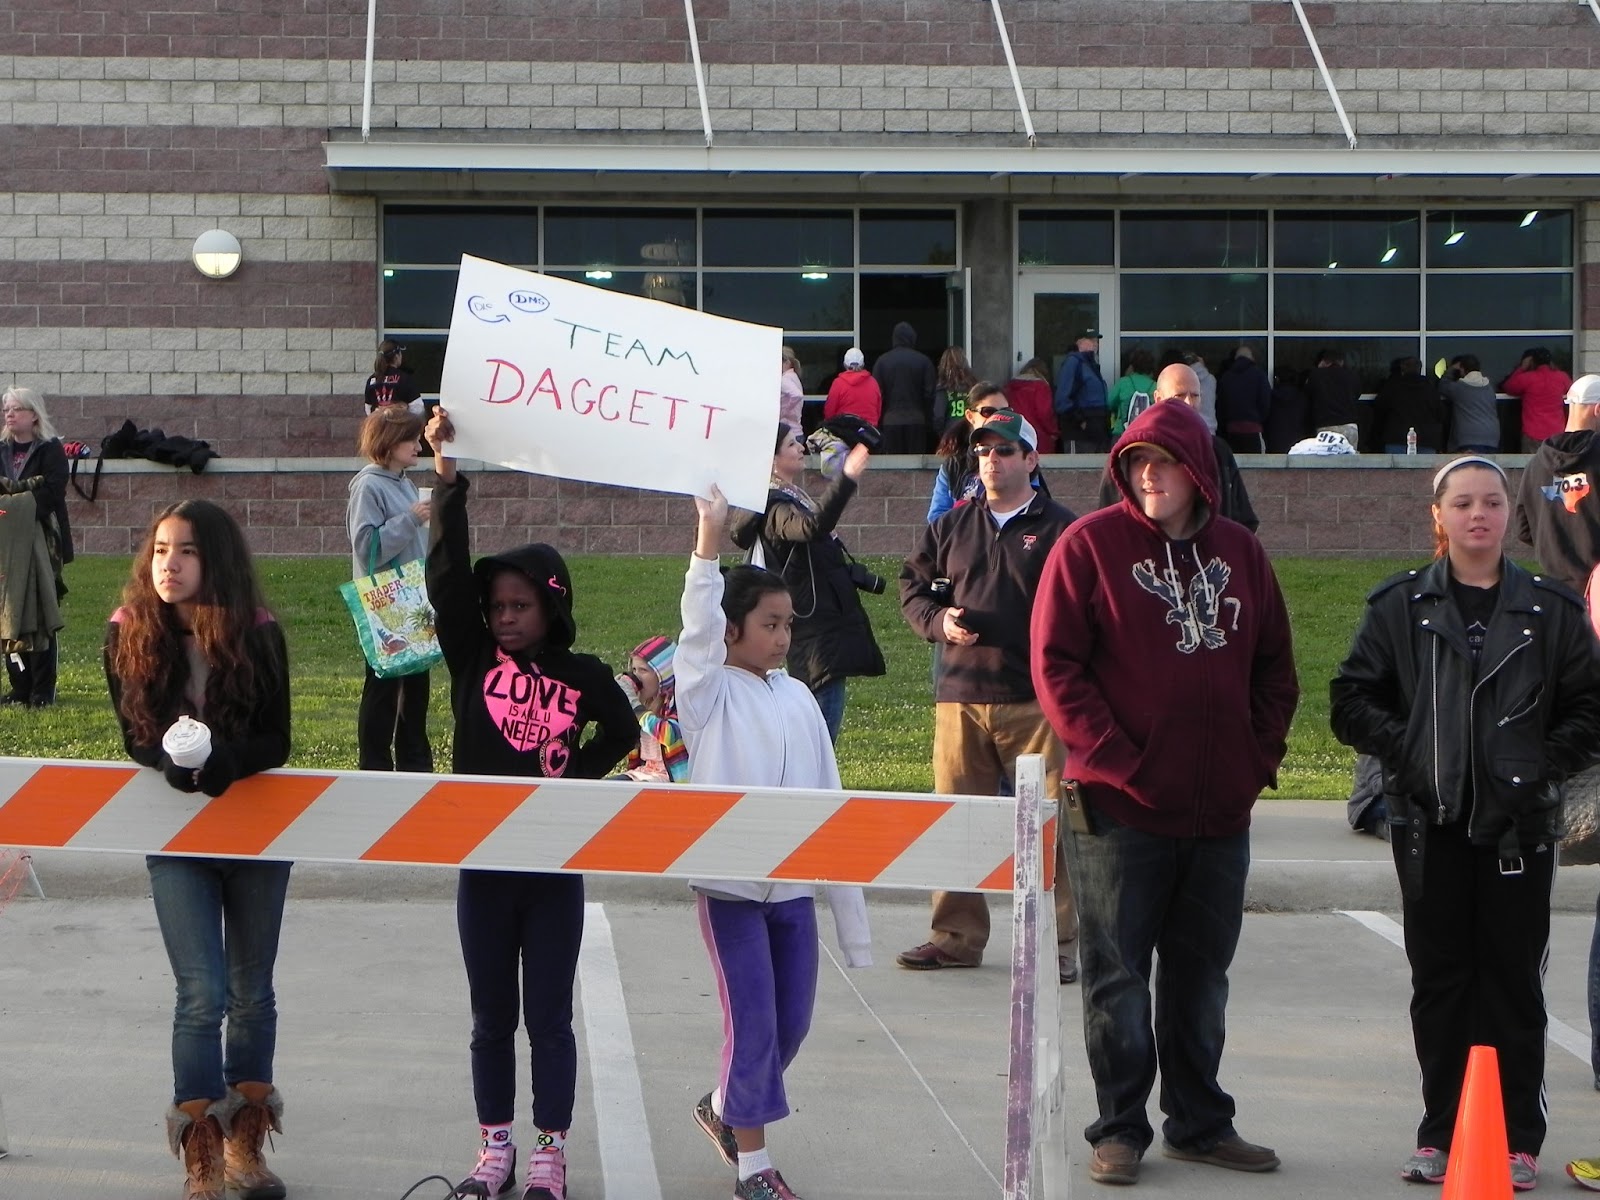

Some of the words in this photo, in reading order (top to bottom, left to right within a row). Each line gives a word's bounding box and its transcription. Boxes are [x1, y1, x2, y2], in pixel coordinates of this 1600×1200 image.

[514, 294, 545, 306] DMS
[553, 318, 700, 375] TEAM
[950, 399, 965, 417] 19
[1554, 477, 1584, 495] 70.3
[363, 579, 404, 603] TRADER
[369, 593, 396, 611] JOE'S
[485, 670, 576, 717] LOVE
[508, 704, 519, 716] IS
[543, 711, 551, 723] U
[500, 716, 551, 745] NEED
